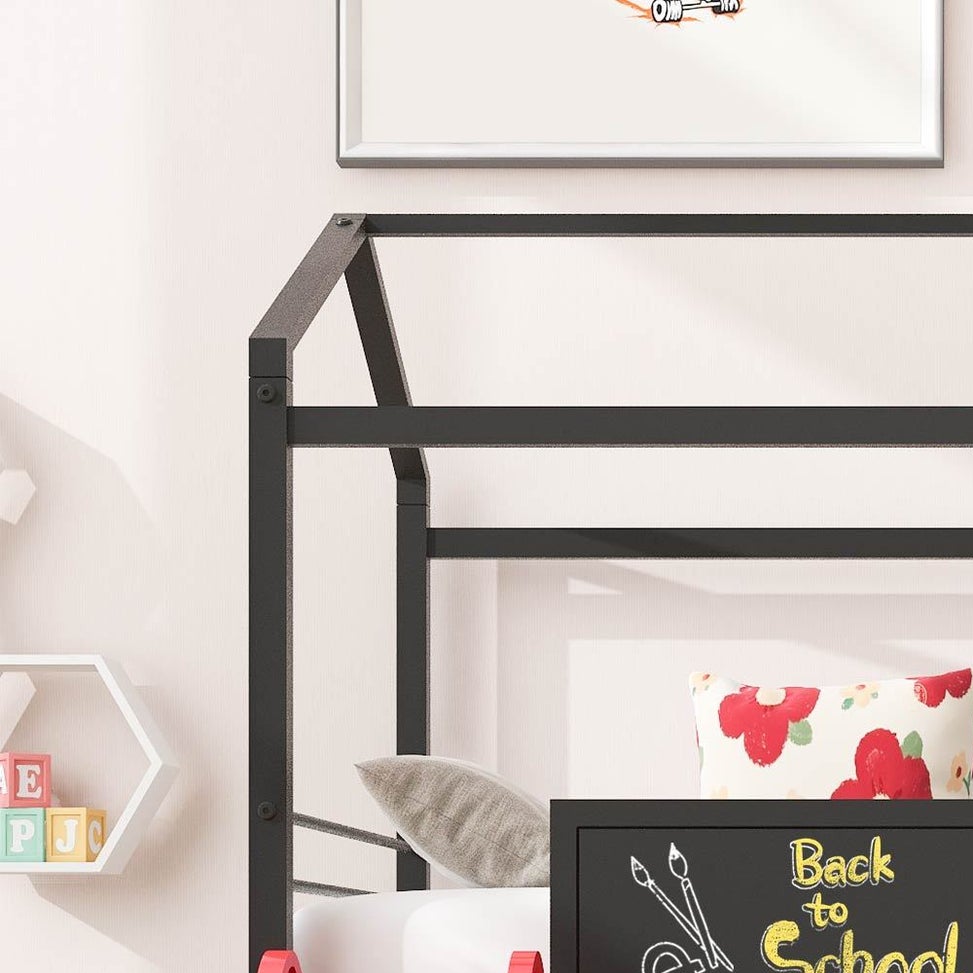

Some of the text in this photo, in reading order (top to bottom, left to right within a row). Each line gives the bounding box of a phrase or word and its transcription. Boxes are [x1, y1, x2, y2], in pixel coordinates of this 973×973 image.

[16, 765, 42, 798] E
[10, 819, 102, 853] P J C
[790, 835, 895, 889] Back
[801, 891, 849, 931] to
